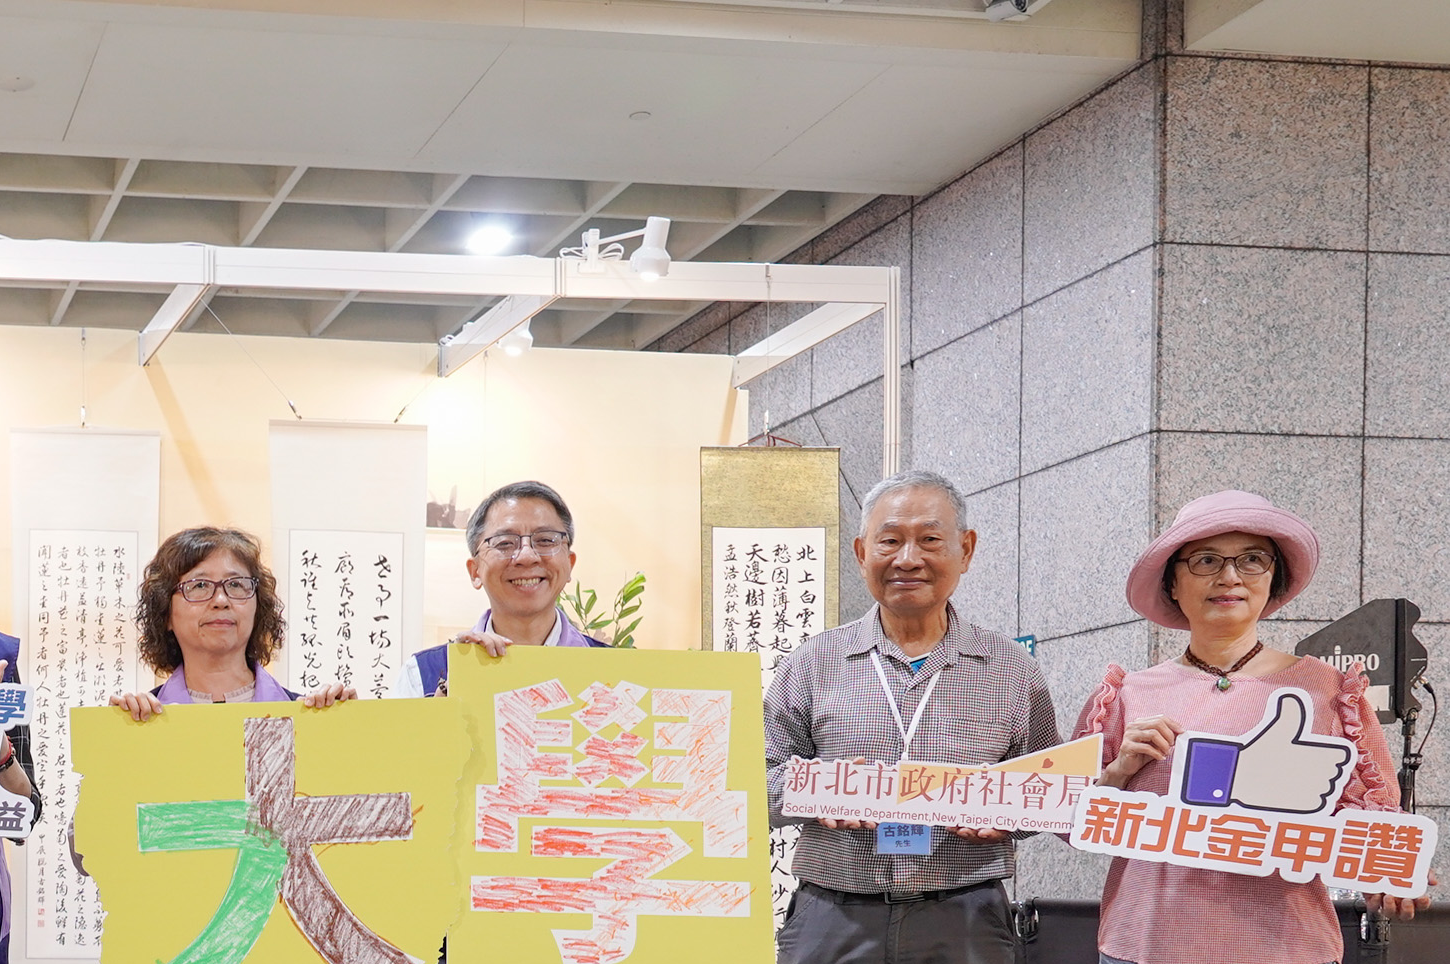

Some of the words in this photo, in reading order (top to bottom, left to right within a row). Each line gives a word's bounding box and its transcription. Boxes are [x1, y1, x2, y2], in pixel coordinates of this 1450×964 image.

[785, 757, 1091, 811] 新北市政府社會局
[785, 802, 817, 815] Social
[820, 804, 861, 818] Welfare
[960, 814, 992, 827] Taipei
[995, 815, 1017, 829] City
[1080, 797, 1424, 889] 新北金甲讚
